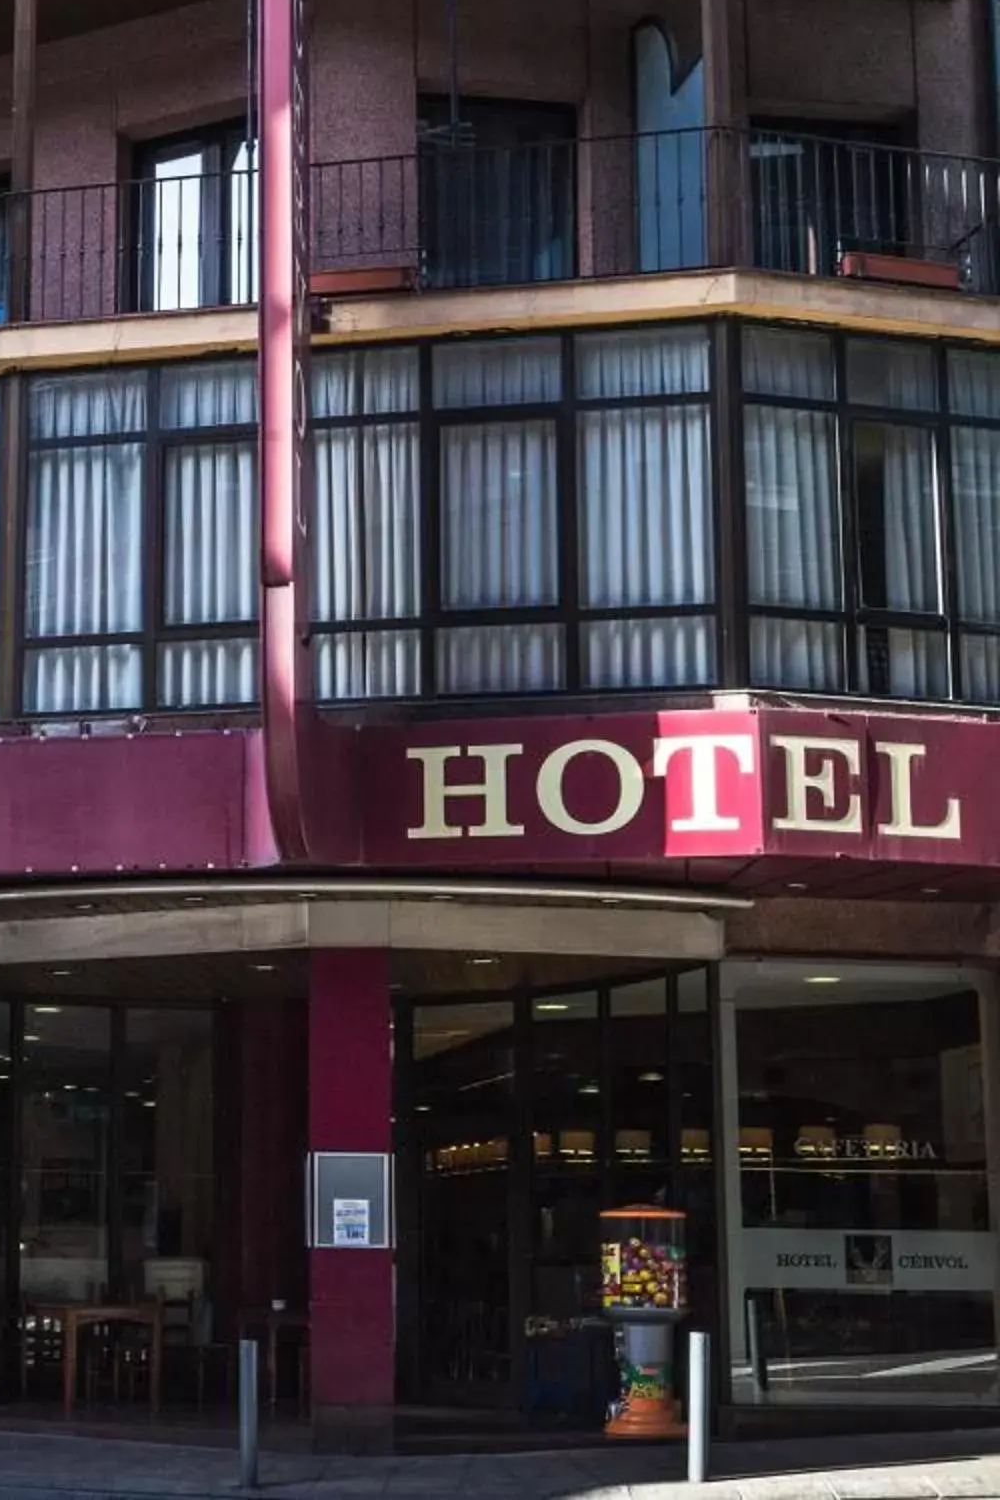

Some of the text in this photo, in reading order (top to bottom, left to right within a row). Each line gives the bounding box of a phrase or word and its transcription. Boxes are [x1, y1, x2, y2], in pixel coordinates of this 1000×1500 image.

[405, 734, 962, 840] HOTEL
[793, 1136, 939, 1161] CAFETERIA
[776, 1252, 839, 1270] HOTEL
